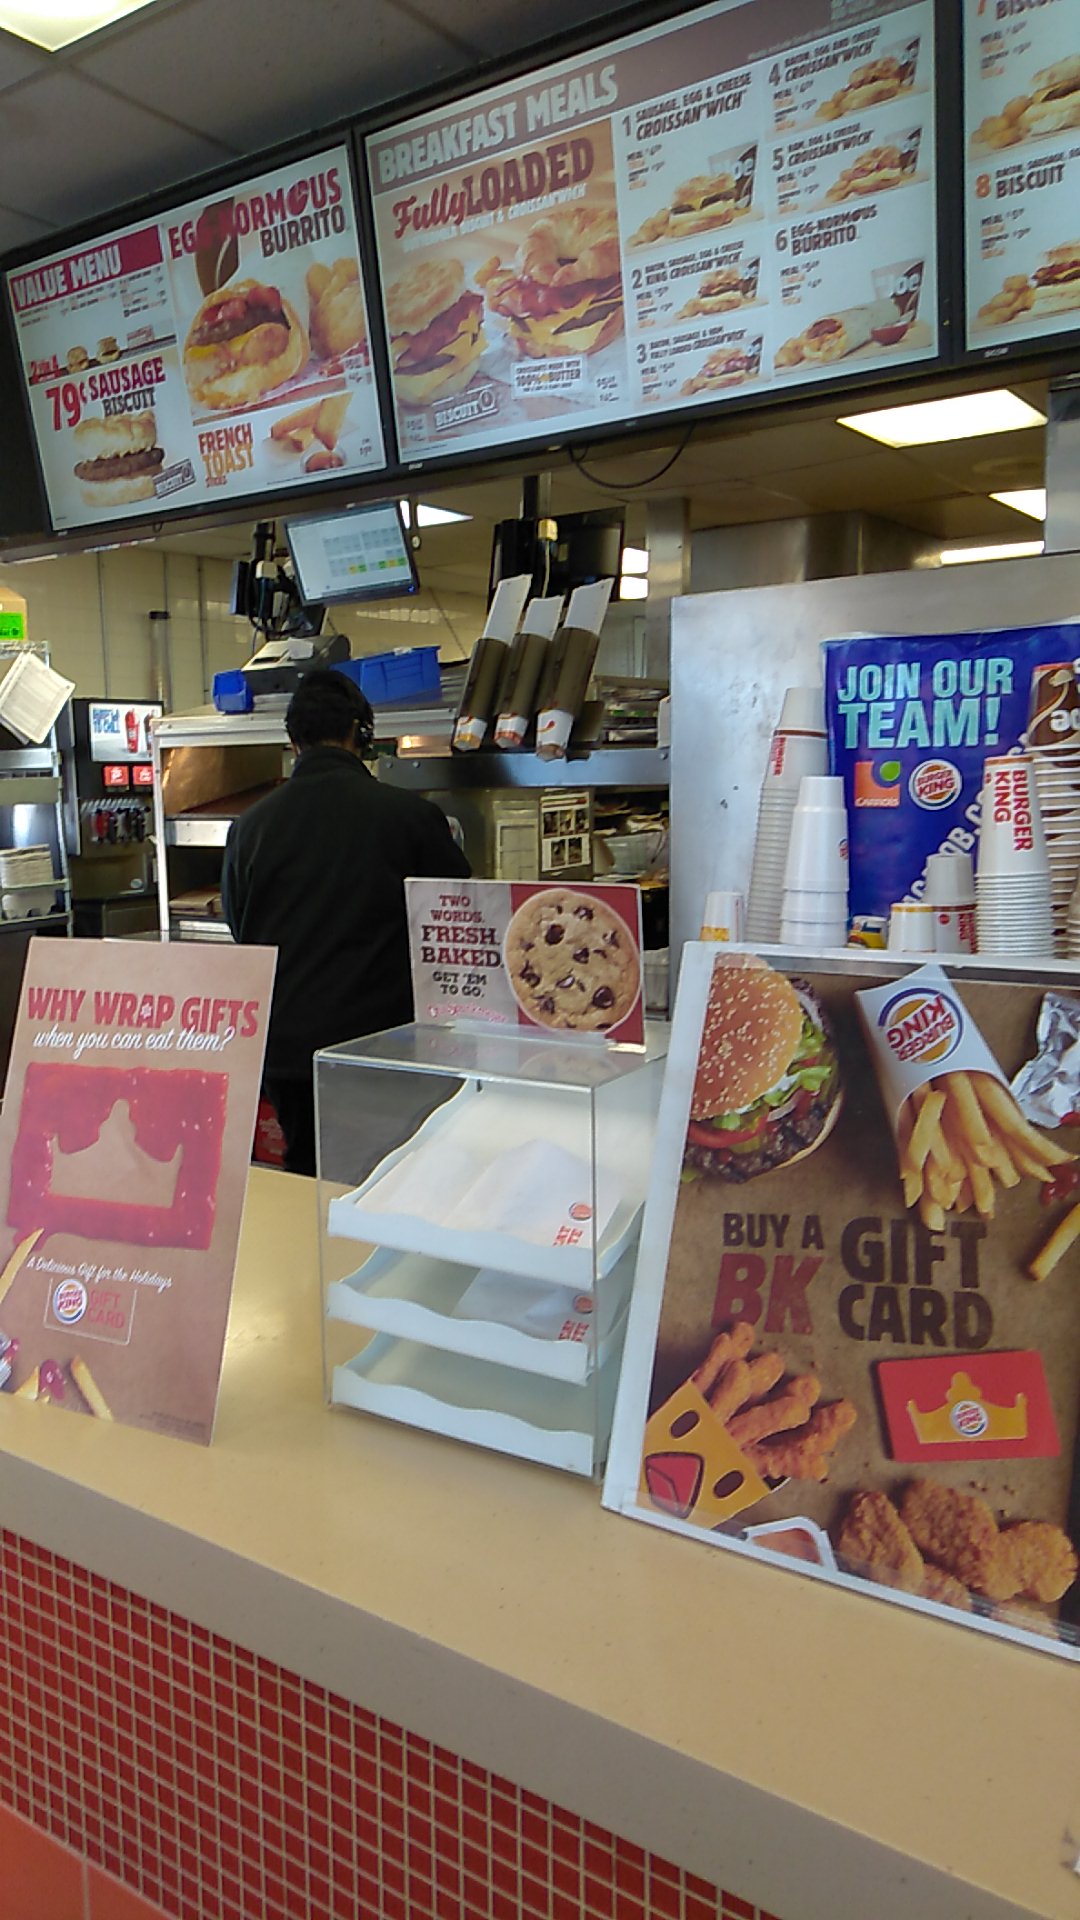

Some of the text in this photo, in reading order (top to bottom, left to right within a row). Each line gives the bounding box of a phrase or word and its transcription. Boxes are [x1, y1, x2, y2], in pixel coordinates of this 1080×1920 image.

[769, 63, 781, 87] 4
[622, 115, 631, 137] 1
[683, 90, 703, 107] EGG
[716, 72, 752, 95] CHEESE
[378, 64, 618, 184] BREAKFAST MEALS
[772, 148, 784, 171] 5
[393, 183, 467, 239] Fully
[462, 138, 595, 215] LOADED
[976, 173, 990, 198] 8
[996, 163, 1065, 199] BISCUIT
[260, 205, 346, 258] BURRITO
[775, 229, 788, 252] 6
[791, 224, 857, 257] BURRITO
[14, 264, 68, 307] VALUE
[69, 244, 123, 288] MENU
[632, 269, 643, 289] 2
[636, 343, 647, 364] 3
[88, 356, 166, 400] SAUSAGE
[103, 387, 156, 417] BISCUIT
[436, 401, 479, 426] BISCUIT
[198, 423, 254, 454] FRENCH
[202, 445, 255, 476] TOAST
[837, 657, 1014, 702] JOIN OUR
[837, 697, 1002, 749] TEAM!
[917, 777, 955, 798] KING
[994, 771, 1012, 825] KING
[1013, 769, 1033, 852] BURGER
[431, 909, 485, 923] WORDS.
[439, 895, 470, 907] TWO
[422, 925, 501, 946] FRESH.
[422, 947, 505, 968] BAKED.
[433, 971, 459, 983] GET
[440, 984, 458, 996] TO
[28, 986, 260, 1037] WHY WRAP GIFTS
[886, 992, 946, 1049] KING
[33, 1024, 236, 1059] when you can eat them?
[898, 1011, 956, 1061] BURGER
[723, 1212, 825, 1250] BUY A
[840, 1215, 988, 1289] GIFT
[27, 1256, 36, 1268] A
[113, 1268, 128, 1281] the
[128, 1269, 172, 1294] Holidays
[89, 1289, 121, 1309] GIFT
[710, 1252, 826, 1335] BK
[87, 1307, 125, 1329] CARD
[838, 1284, 993, 1349] CARD
[958, 1414, 983, 1428] KING
